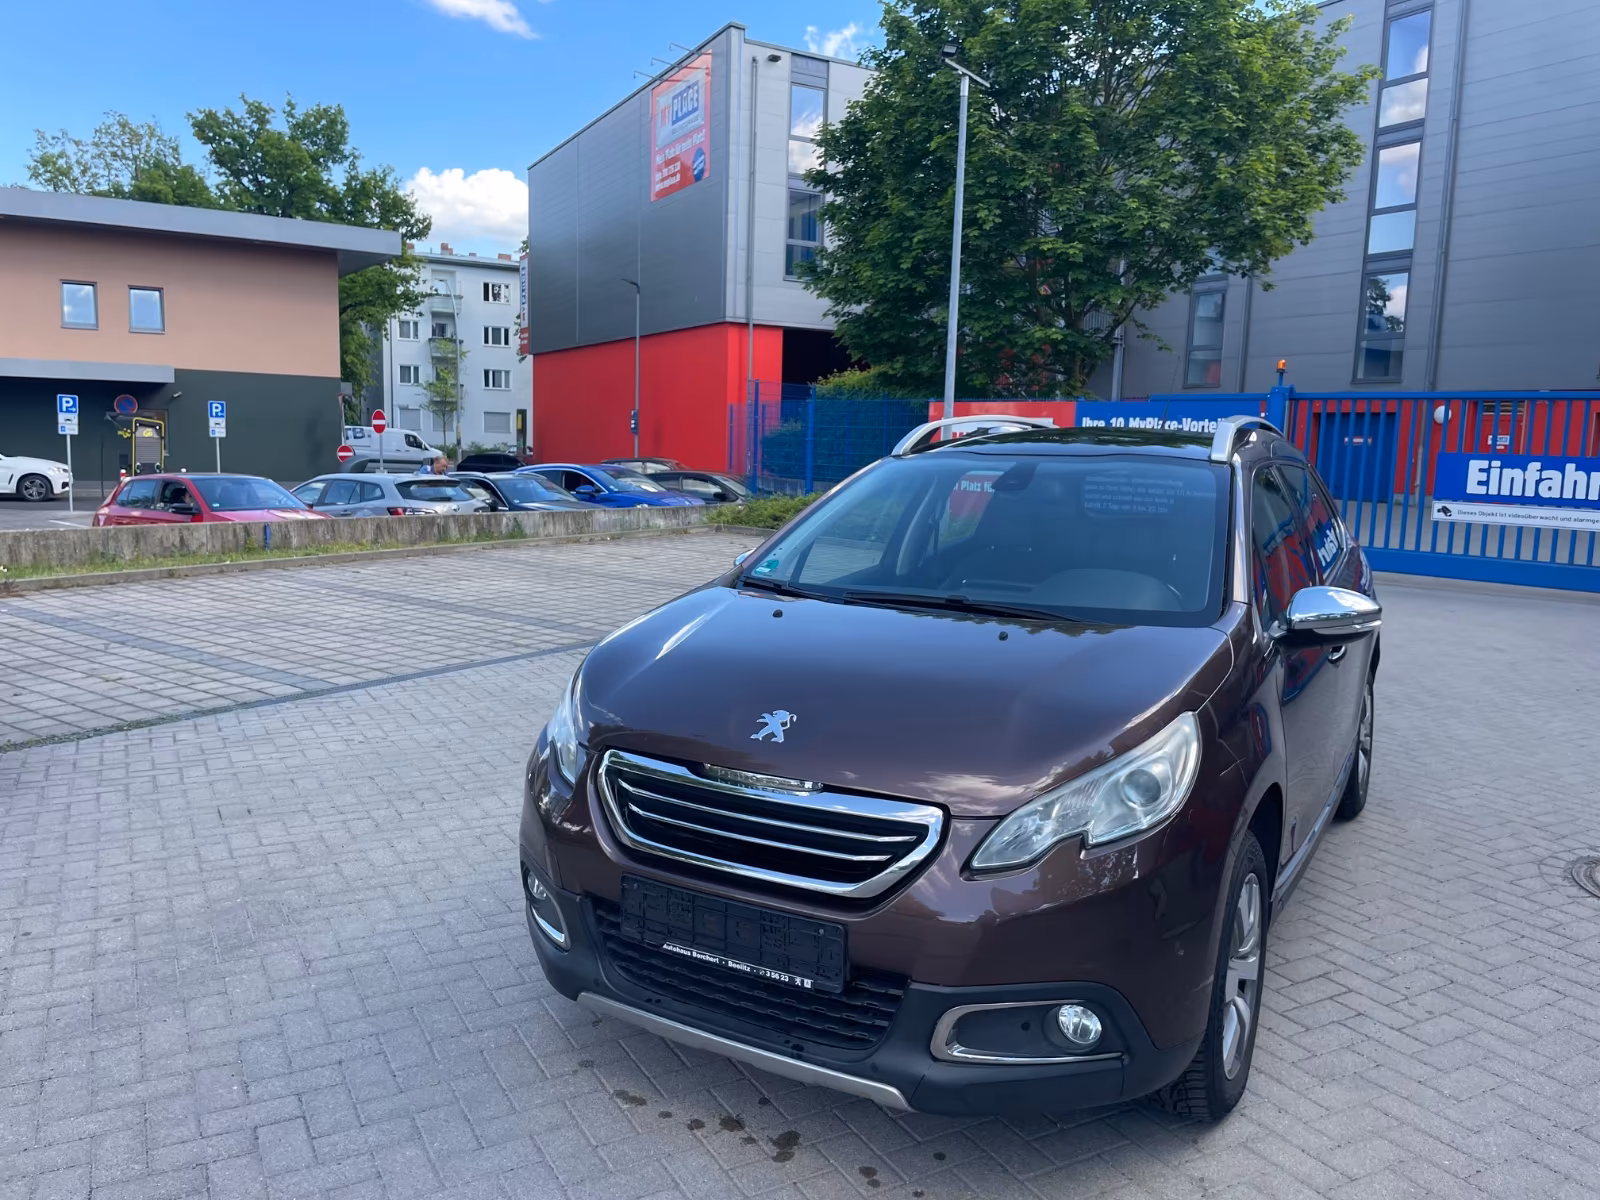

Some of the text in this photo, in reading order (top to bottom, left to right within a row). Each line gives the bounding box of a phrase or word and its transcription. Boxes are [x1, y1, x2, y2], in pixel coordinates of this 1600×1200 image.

[673, 84, 698, 120] PLACE
[62, 397, 73, 411] P
[212, 403, 222, 416] P
[1082, 416, 1106, 427] Ihre
[961, 480, 981, 491] Platz
[984, 482, 995, 492] fü
[1508, 512, 1559, 520] videoüberwacht
[662, 943, 691, 956] Autohaus
[692, 951, 719, 963] Borchert
